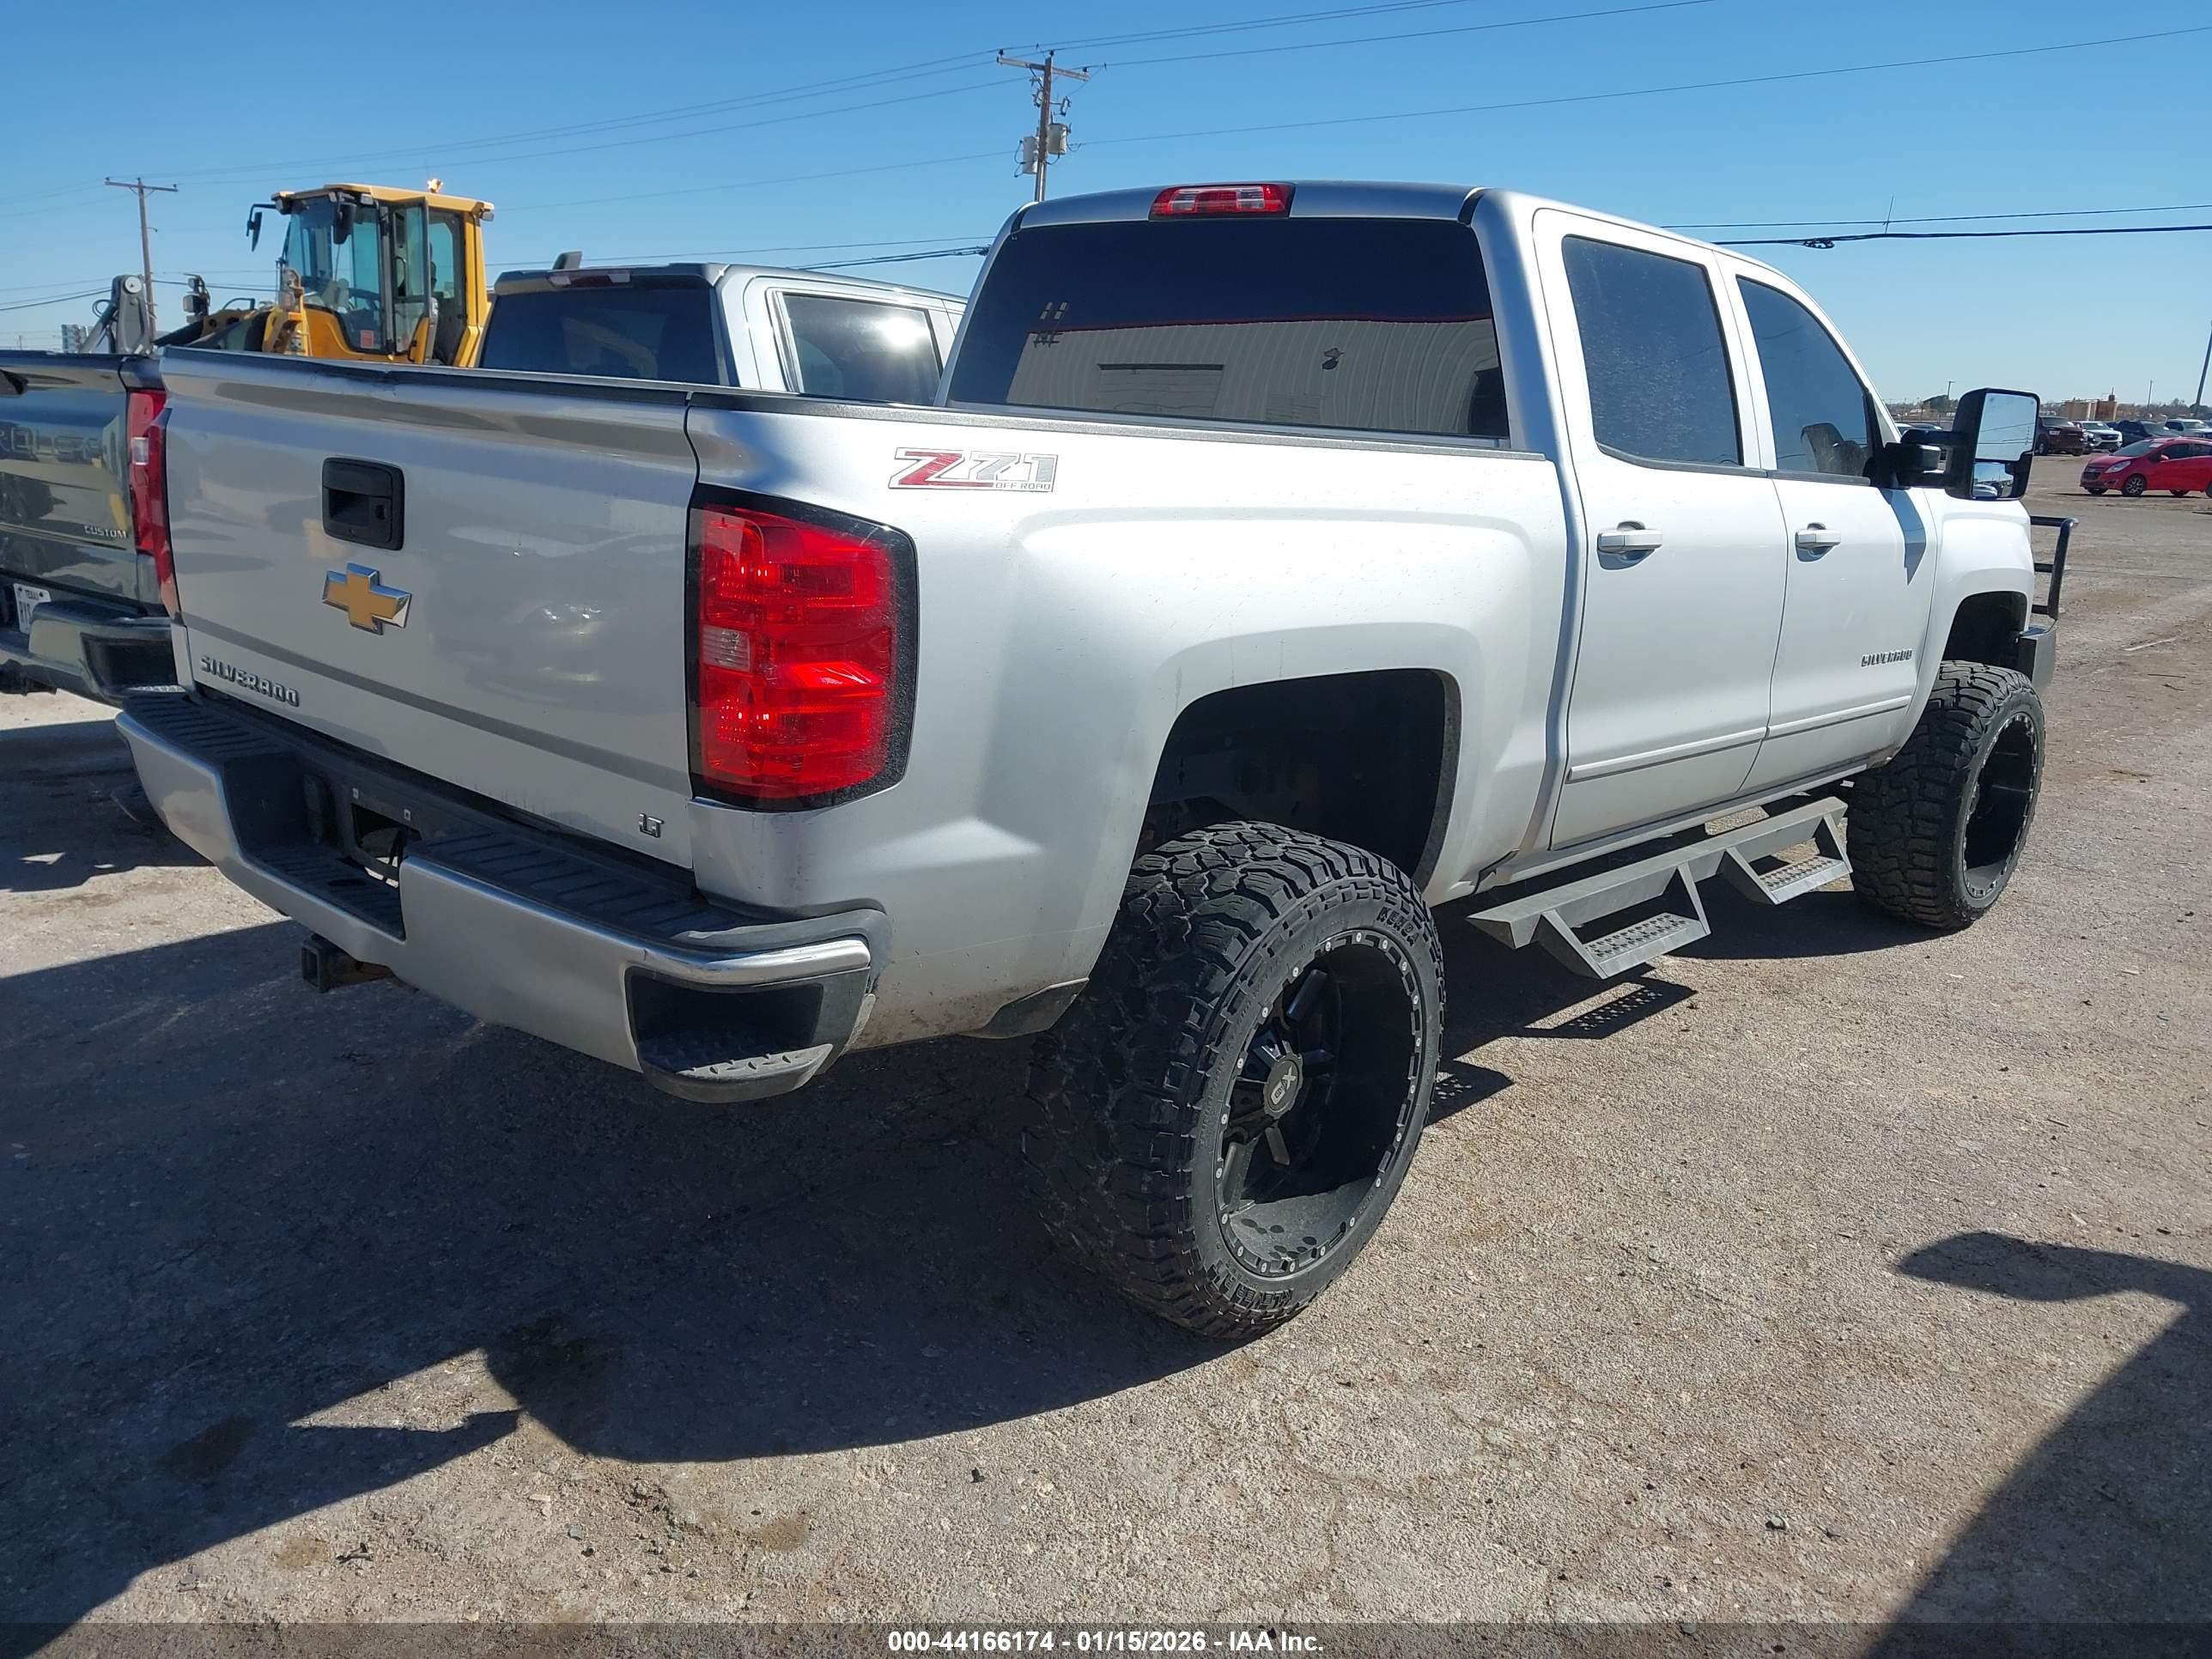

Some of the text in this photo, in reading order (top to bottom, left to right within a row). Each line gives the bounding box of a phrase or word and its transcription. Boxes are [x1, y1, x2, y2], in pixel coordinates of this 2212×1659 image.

[889, 447, 1058, 492] Z71
[84, 526, 127, 539] CUSTOM
[1861, 649, 1913, 667] SILVERADO
[200, 655, 300, 708] SILVERADO
[639, 812, 665, 838] LT
[1376, 906, 1419, 946] KENDA
